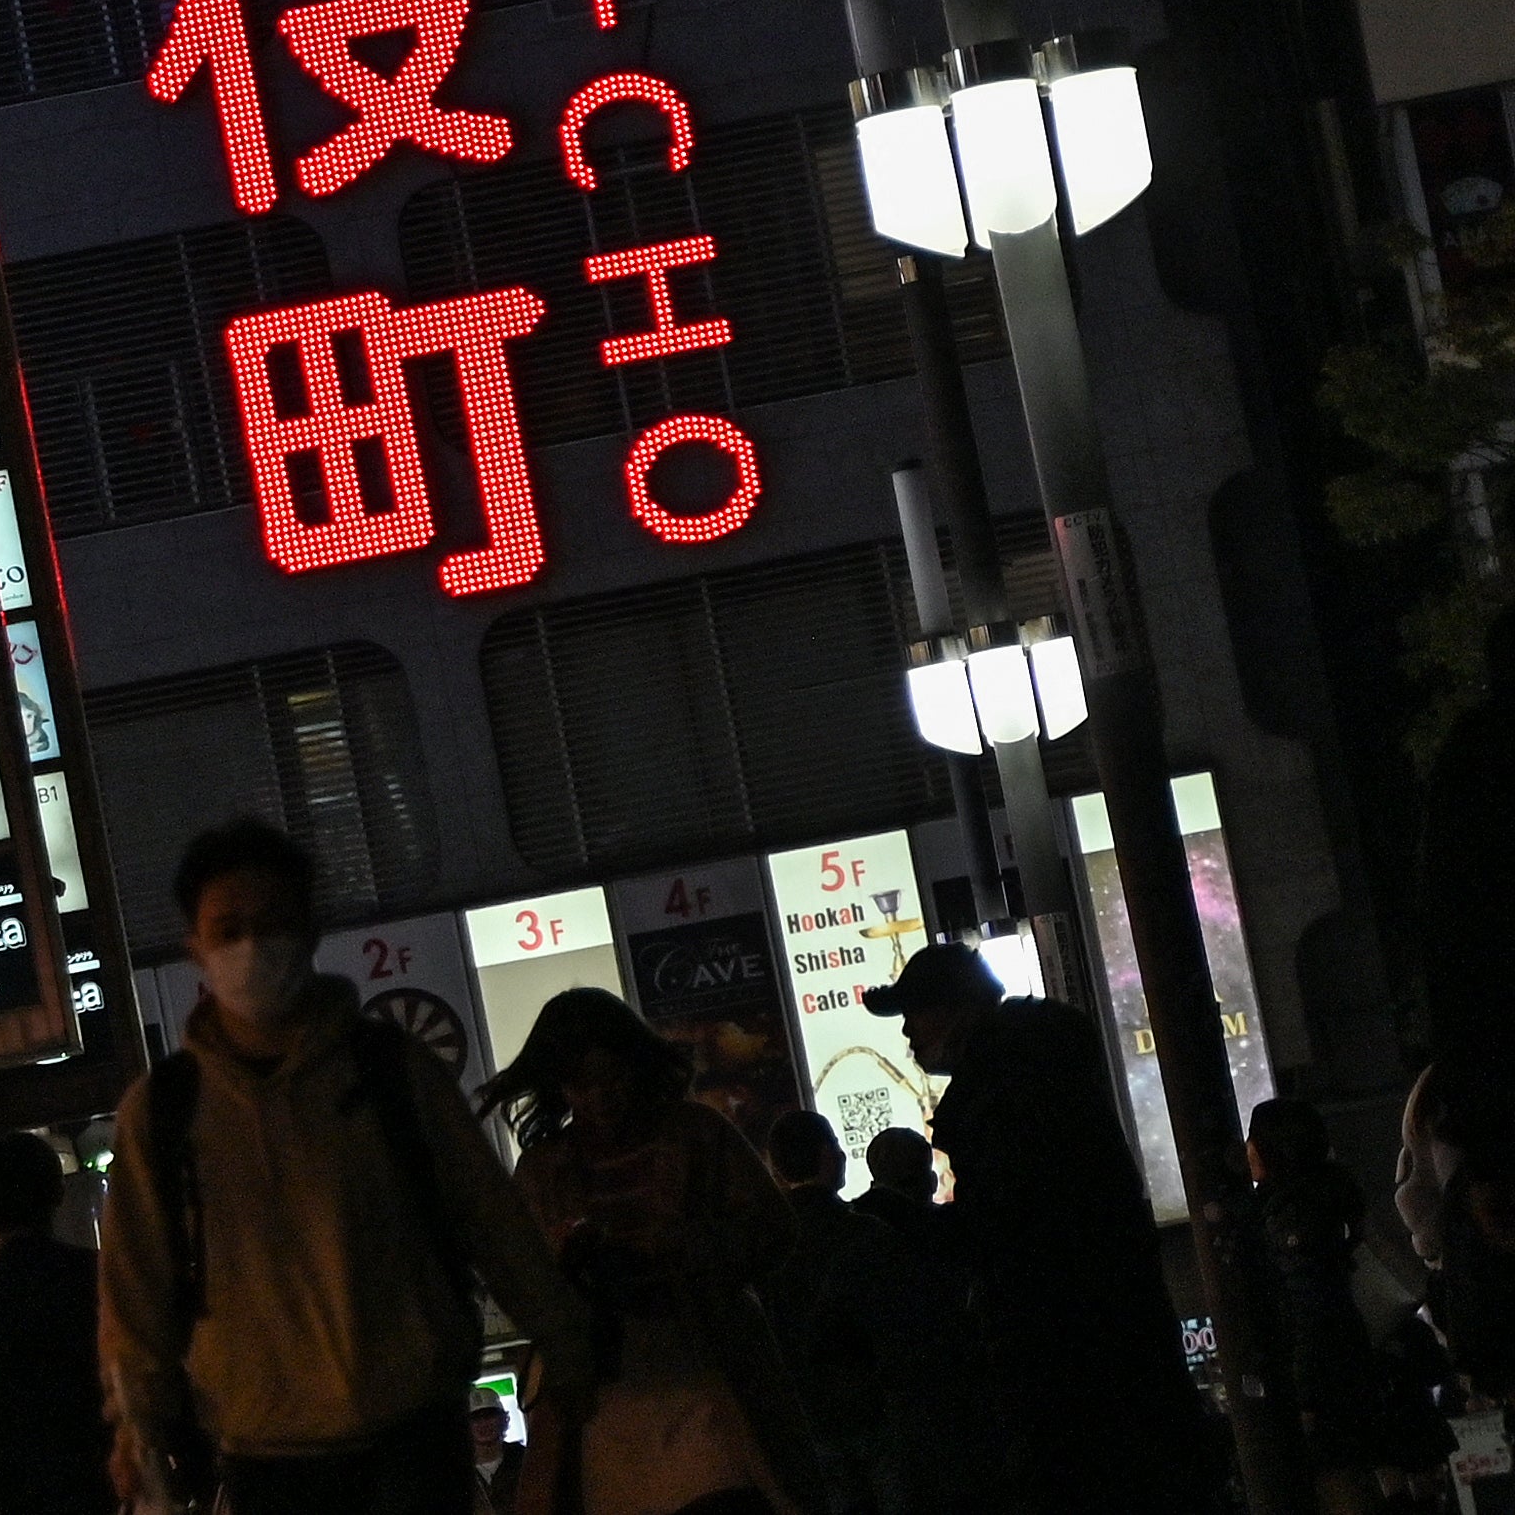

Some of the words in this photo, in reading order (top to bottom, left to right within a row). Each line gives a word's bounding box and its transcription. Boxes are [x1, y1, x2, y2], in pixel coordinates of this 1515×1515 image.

[38, 786, 59, 805] B1
[820, 850, 866, 892] 5F
[664, 877, 711, 918] 4F
[515, 910, 565, 951] 3F
[786, 902, 865, 934] Hookah
[363, 939, 412, 980] 2F
[794, 944, 866, 975] Shisha
[802, 988, 849, 1015] Cafe
